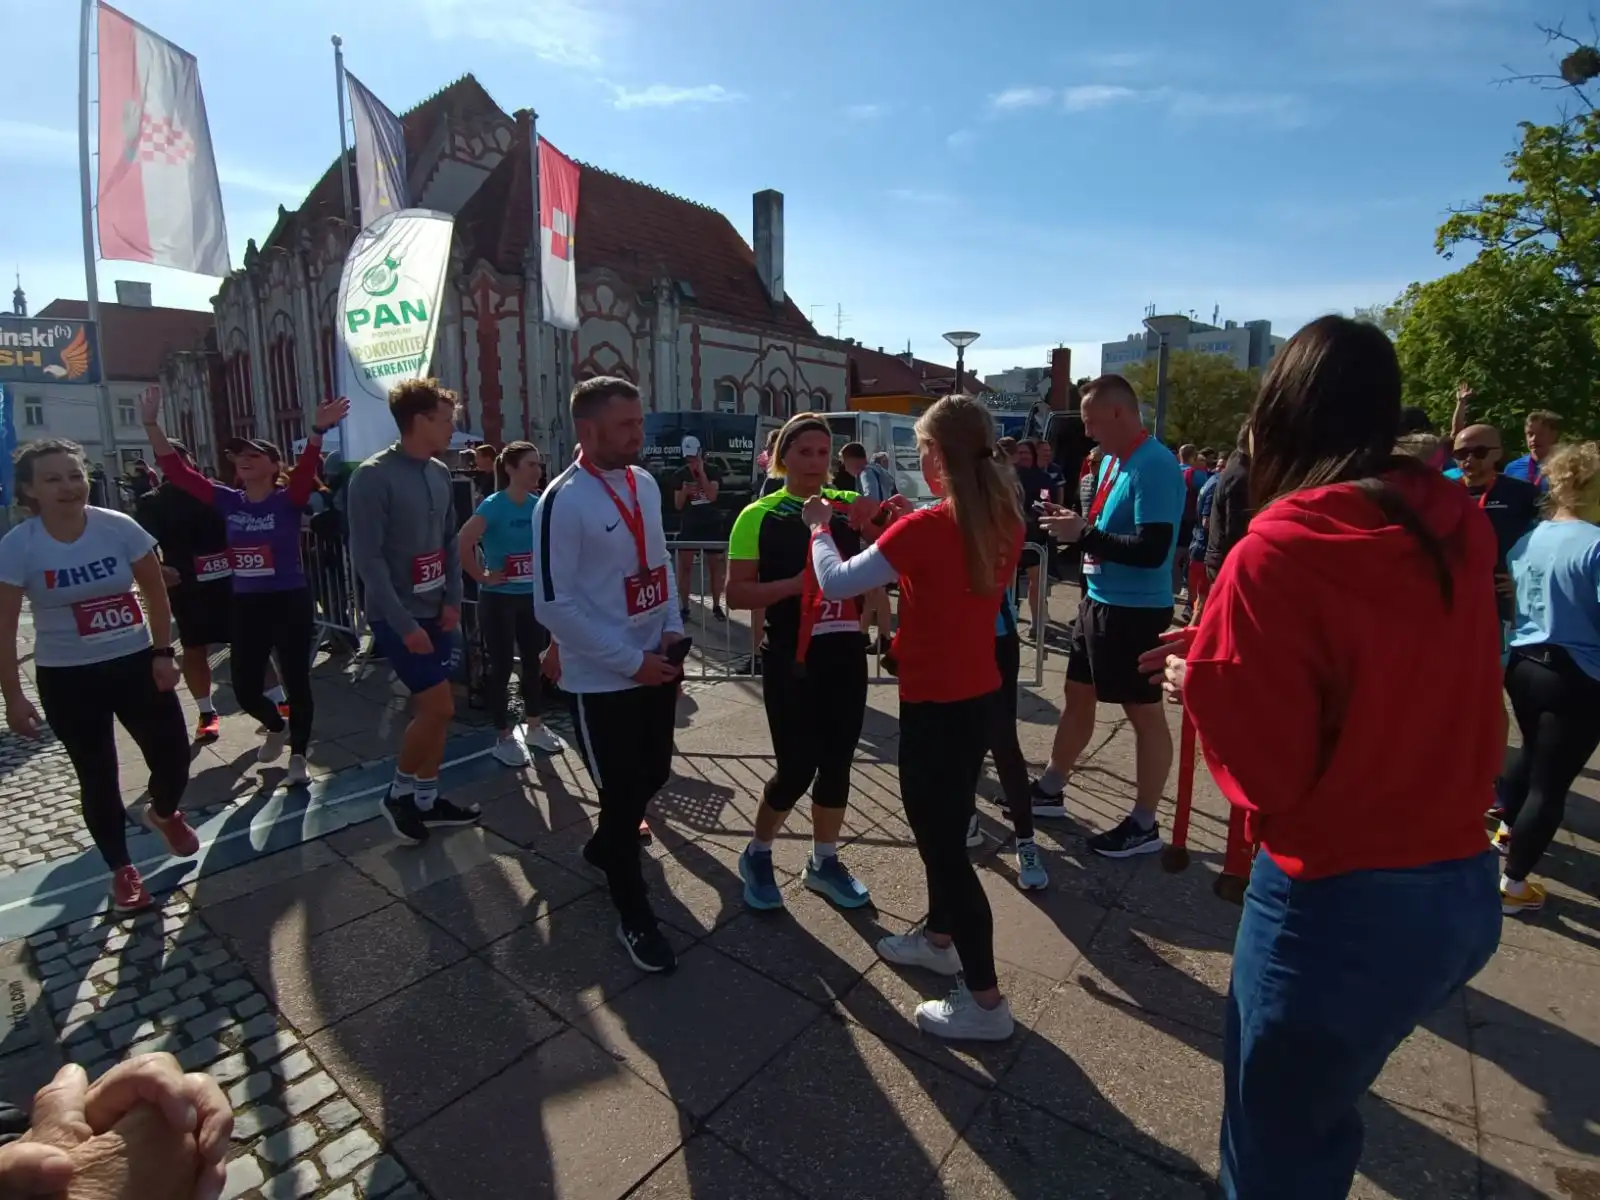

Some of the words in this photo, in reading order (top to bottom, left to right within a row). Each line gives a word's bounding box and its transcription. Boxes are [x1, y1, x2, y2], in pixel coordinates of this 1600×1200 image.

[346, 299, 427, 333] PAN
[728, 436, 754, 449] utrka
[69, 556, 118, 585] HEP
[202, 558, 229, 573] 488
[235, 554, 264, 569] 399
[421, 560, 442, 582] 379
[636, 581, 662, 609] 491
[90, 606, 134, 630] 406
